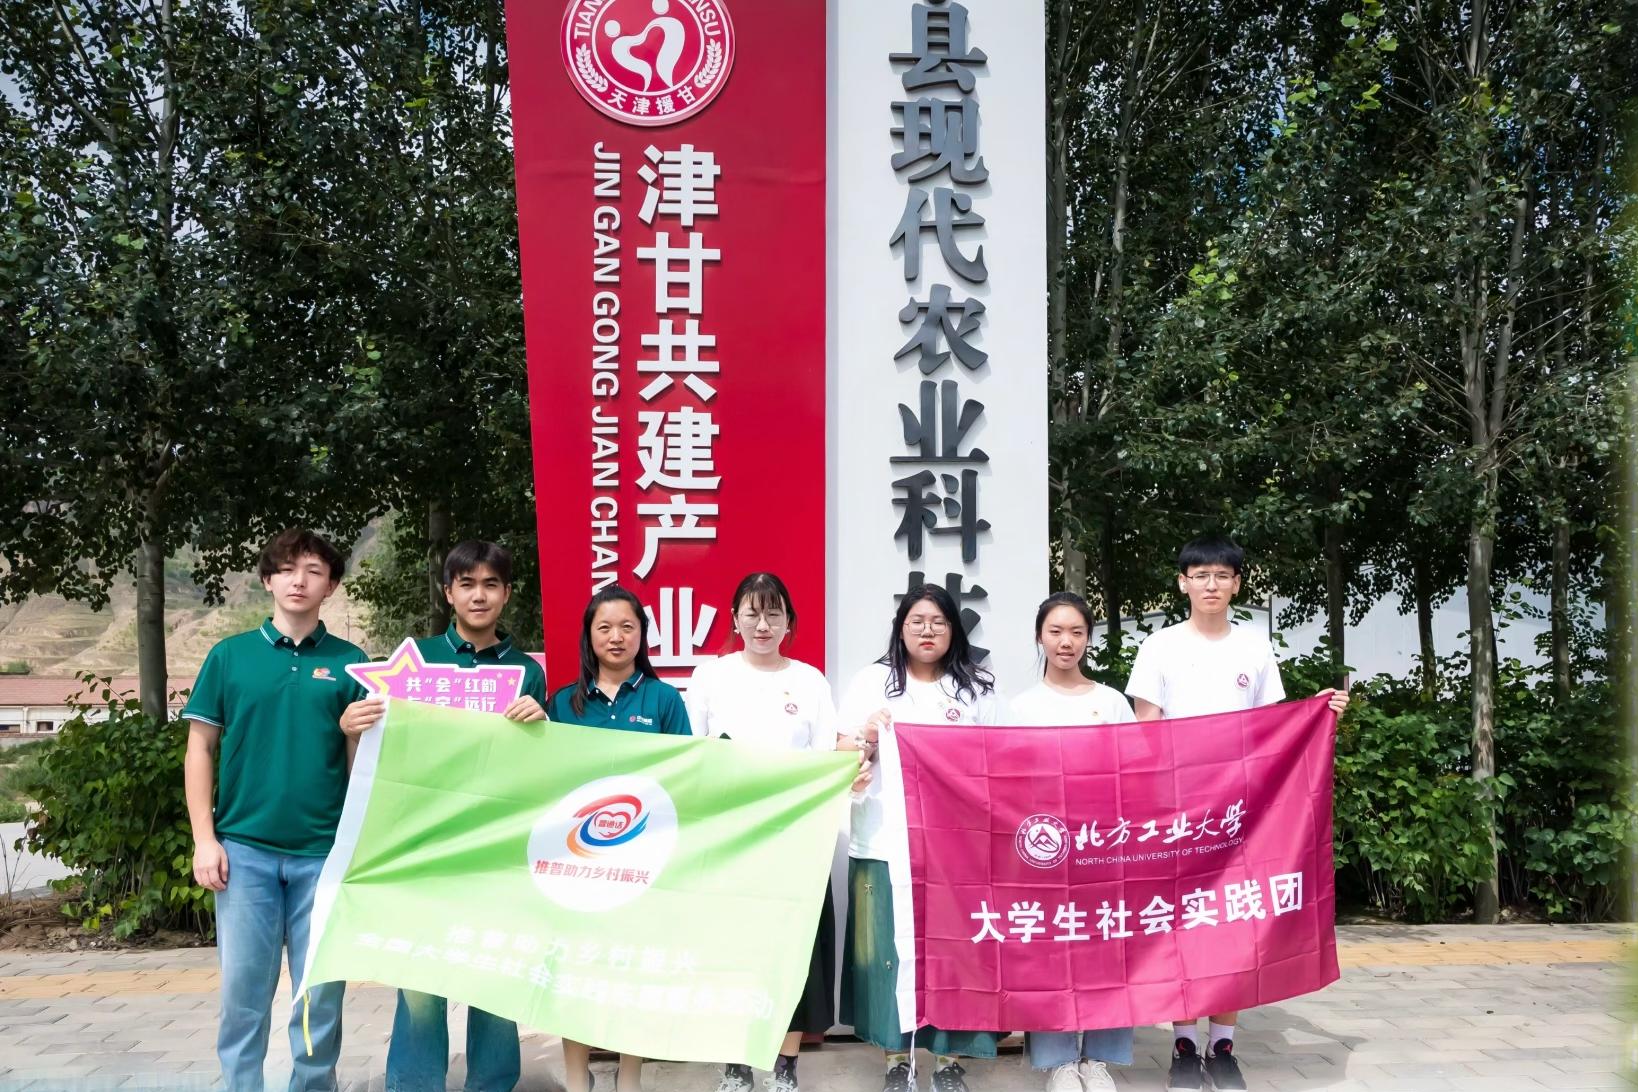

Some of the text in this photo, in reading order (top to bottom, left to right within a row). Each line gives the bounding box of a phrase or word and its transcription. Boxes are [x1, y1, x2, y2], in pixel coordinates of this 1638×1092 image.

[608, 86, 696, 115] 天津援甘
[593, 141, 620, 197] JIN
[593, 206, 620, 282] GAN
[592, 291, 620, 396] GONG
[591, 406, 619, 486] JIAN
[633, 144, 722, 700] 津甘共建产业
[1075, 799, 1247, 850] 北方工业大学
[1075, 838, 1244, 866] NORTH CHINA UNIVERSITY OF TECHNOLOGY
[970, 871, 1304, 944] 大学生社会实践团
